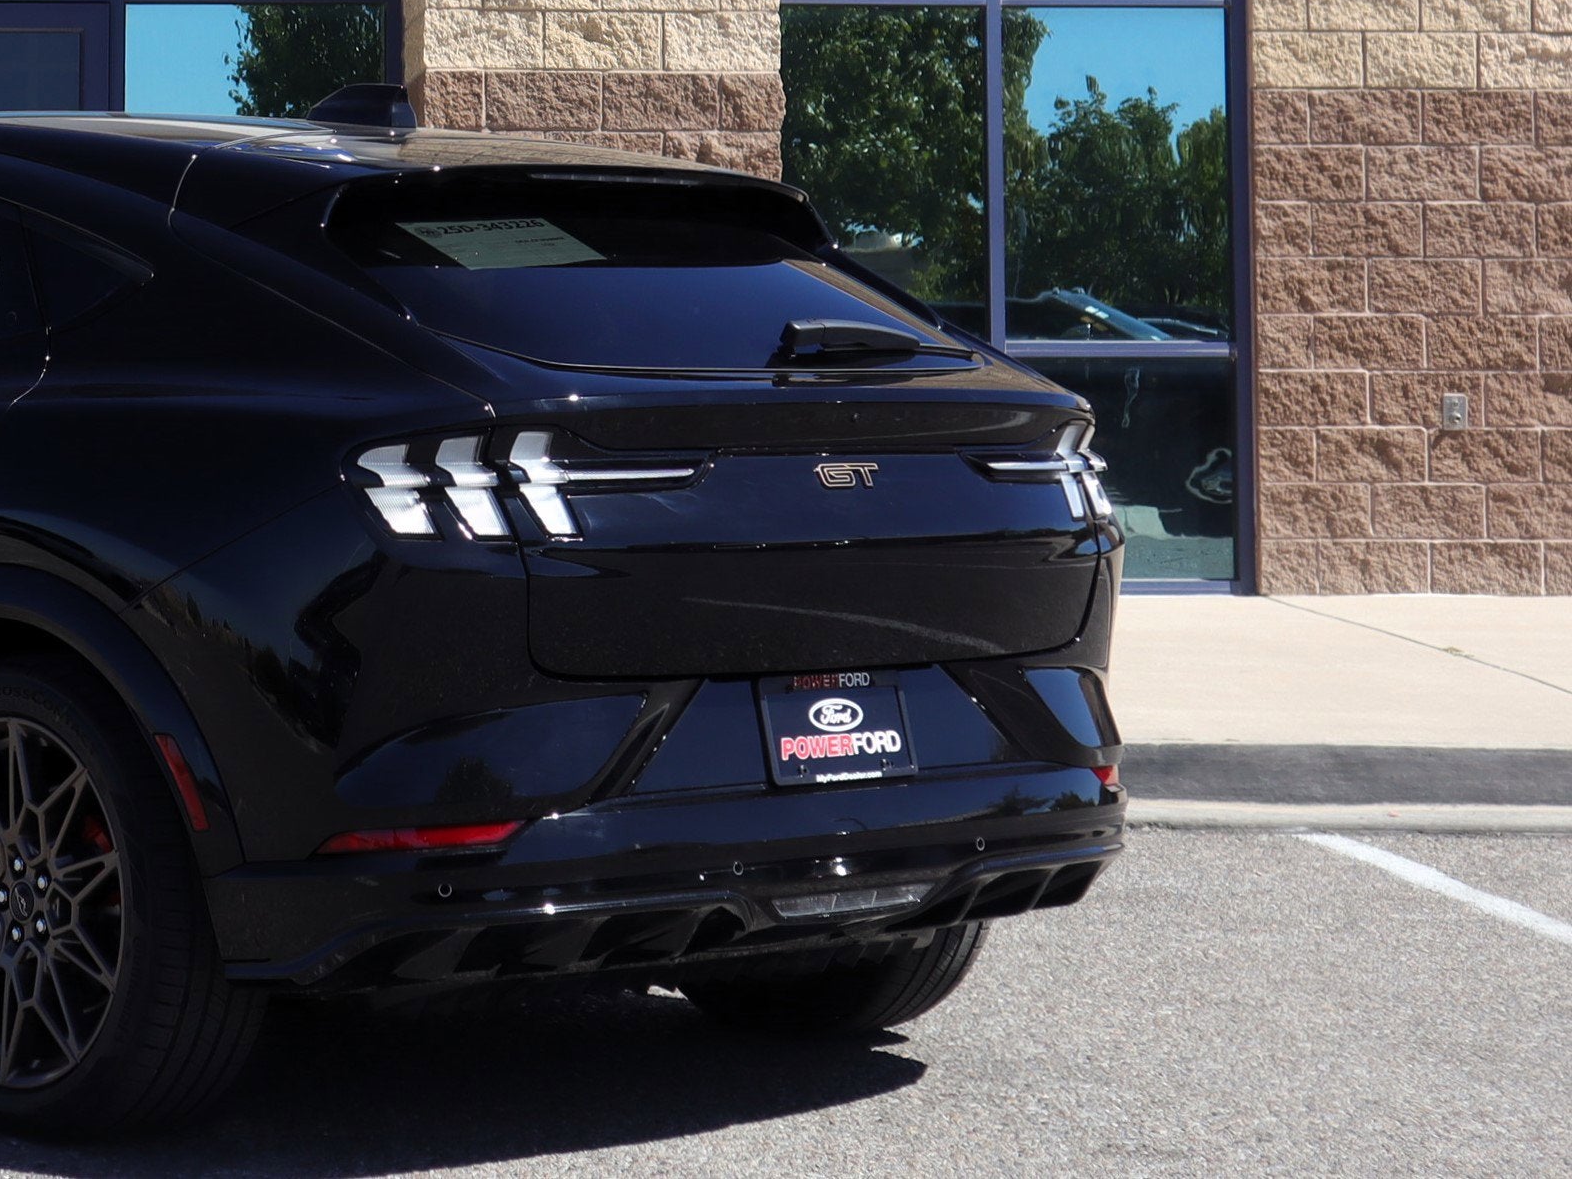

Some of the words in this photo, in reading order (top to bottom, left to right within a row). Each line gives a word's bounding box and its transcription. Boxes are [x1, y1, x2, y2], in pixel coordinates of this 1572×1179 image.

[813, 462, 879, 488] GT
[819, 704, 852, 724] Ford
[781, 730, 901, 760] POWERFORD
[816, 771, 882, 783] MyFordDealer.com
